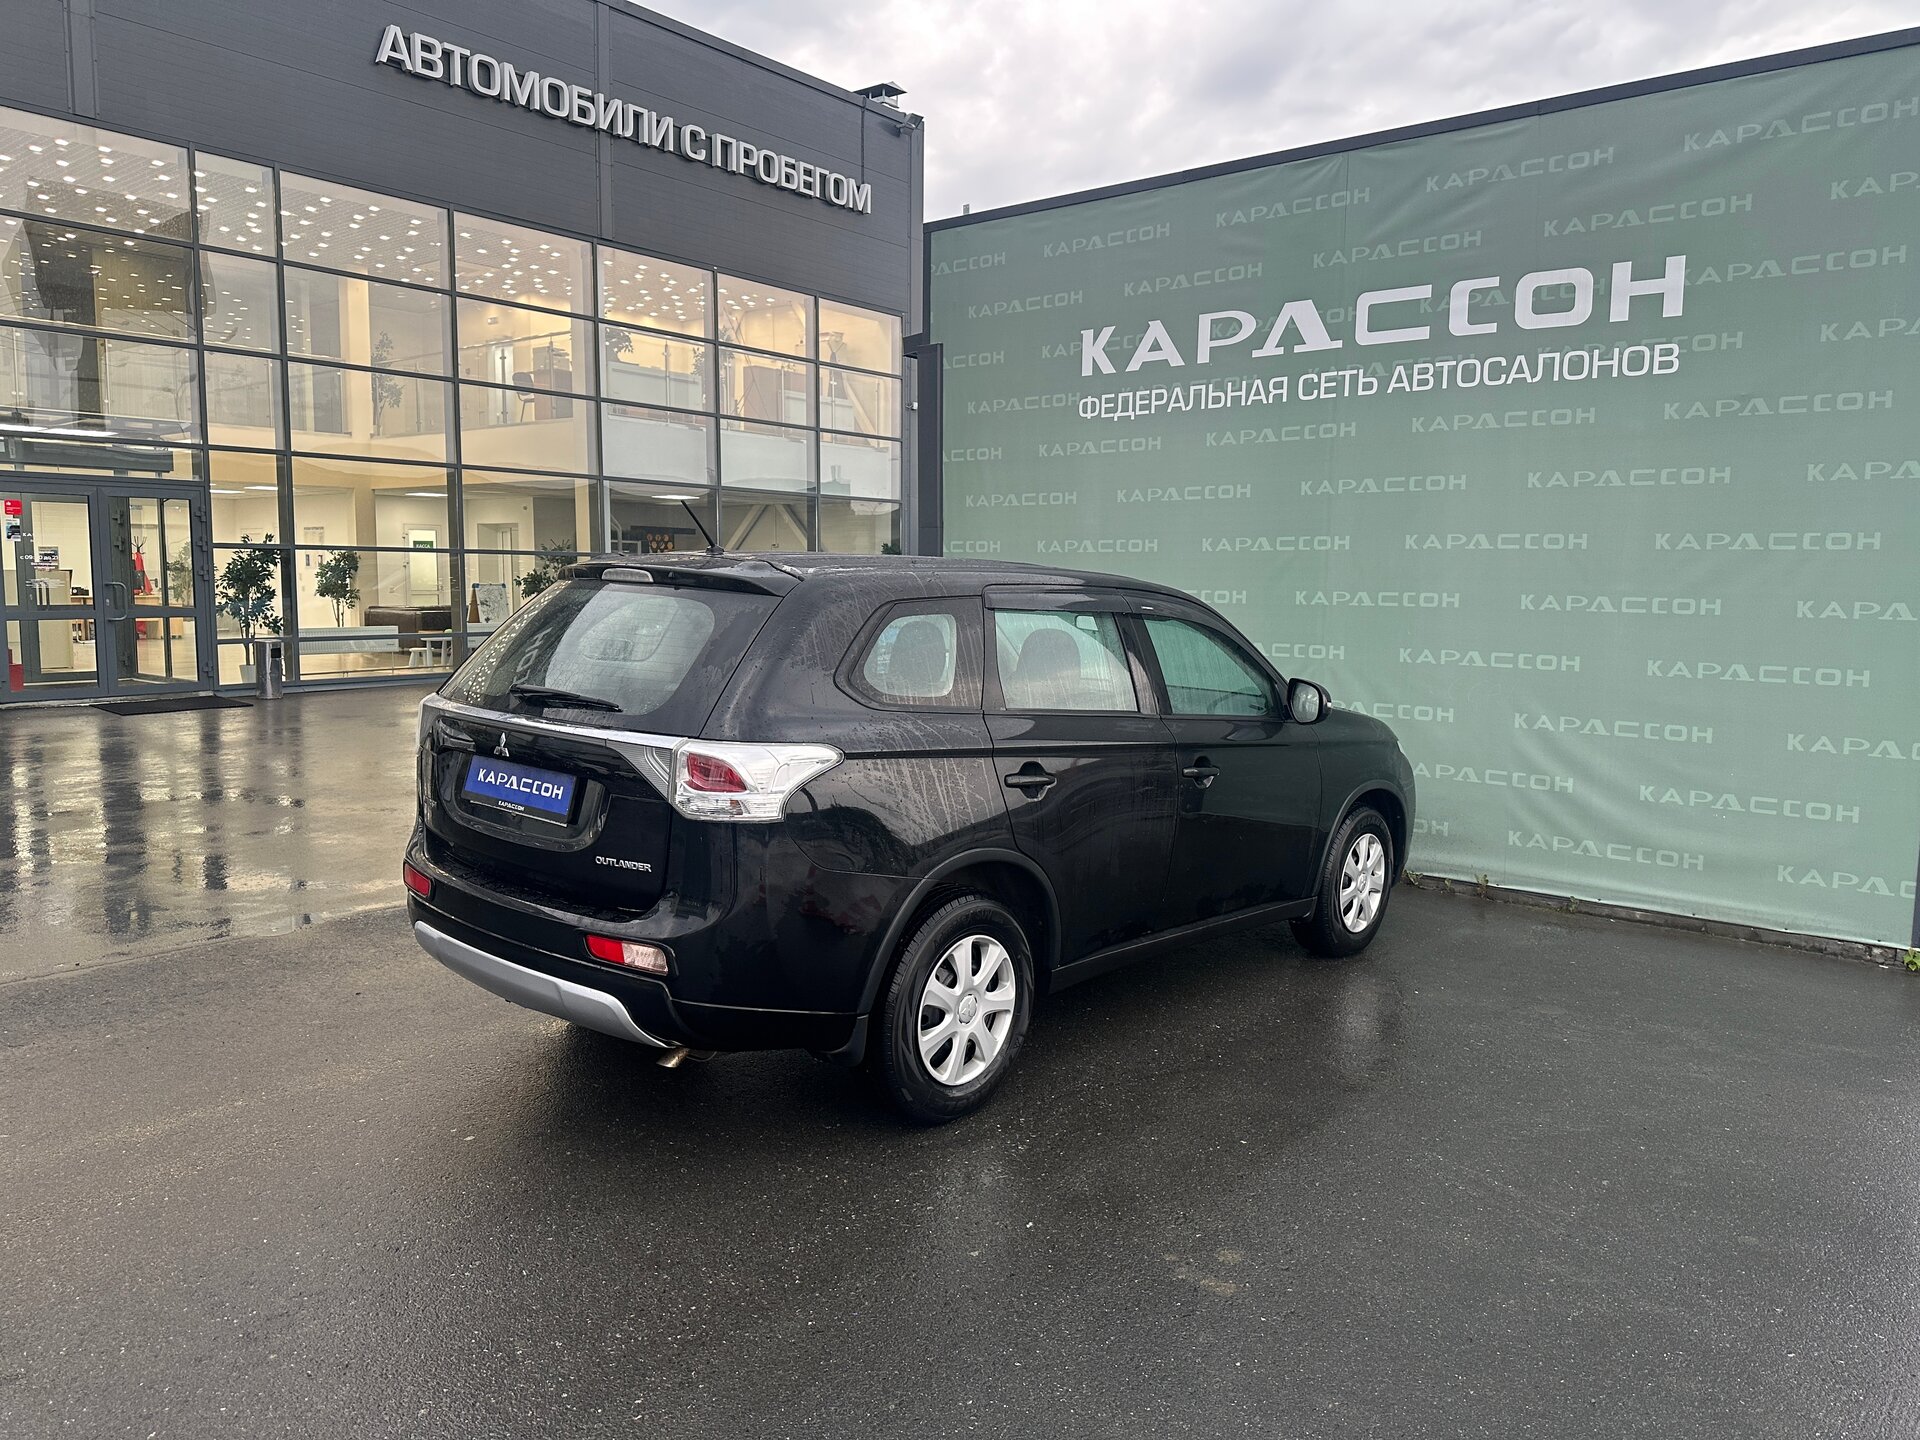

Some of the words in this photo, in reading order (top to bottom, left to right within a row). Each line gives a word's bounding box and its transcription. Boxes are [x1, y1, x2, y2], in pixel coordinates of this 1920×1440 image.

[375, 23, 674, 152] АВТОМОБИЛИ
[680, 124, 706, 161] С
[711, 132, 872, 215] ПРОБЕГОМ
[1683, 97, 1920, 152] КАРАССОН
[1426, 147, 1615, 193] КАРАССОН
[1829, 171, 1920, 200] КАР
[1215, 187, 1370, 228] КАРАССОН
[1543, 193, 1753, 237] КАРАССОН
[1043, 222, 1171, 258] КАРАССОН
[1312, 230, 1482, 269] КАРАССОН
[1124, 263, 1263, 297] КАРАССОН
[1683, 245, 1907, 287] АРАССОН
[968, 290, 1083, 319] КАРАССОН
[1080, 254, 1687, 377] КАРАССОН
[1078, 377, 1288, 421] ФЕДЕРАЛЬНАЯ
[1297, 368, 1378, 402] СЕТЬ
[1386, 343, 1680, 394] АВТОСАЛОНОВ
[967, 392, 1080, 414] КАРАССОН
[1663, 390, 1894, 420] КАРАССОН
[1206, 421, 1357, 447] КАРАССОН
[1411, 407, 1596, 433] КАРАССОН
[1038, 437, 1162, 457] КАРАССОН
[1300, 474, 1467, 496] КАРАССОН
[1527, 467, 1732, 488] КАРАССОН
[965, 491, 1078, 508] КАРАССОН
[1117, 484, 1252, 503] КАРАССОН
[1037, 539, 1159, 553] КАРАССОН
[1202, 535, 1351, 552] КАРАССОН
[1404, 533, 1588, 550] КАРАССОН
[1655, 532, 1882, 551] КАРАССОН
[1295, 590, 1461, 609] КАРАССОН
[1520, 594, 1722, 616] КАРАССОН
[1400, 648, 1581, 673] КАРАССОН
[1647, 659, 1871, 688] КАРАССОН
[1513, 712, 1714, 744] КАРАССОН
[1787, 733, 1920, 761] КАРА
[477, 768, 564, 800] КАРАССОН
[498, 800, 525, 811] КАРАССОН
[1639, 785, 1861, 824] КАРАССОН
[595, 855, 652, 873] OUTLANDER
[1508, 830, 1705, 872] КАРАССОН
